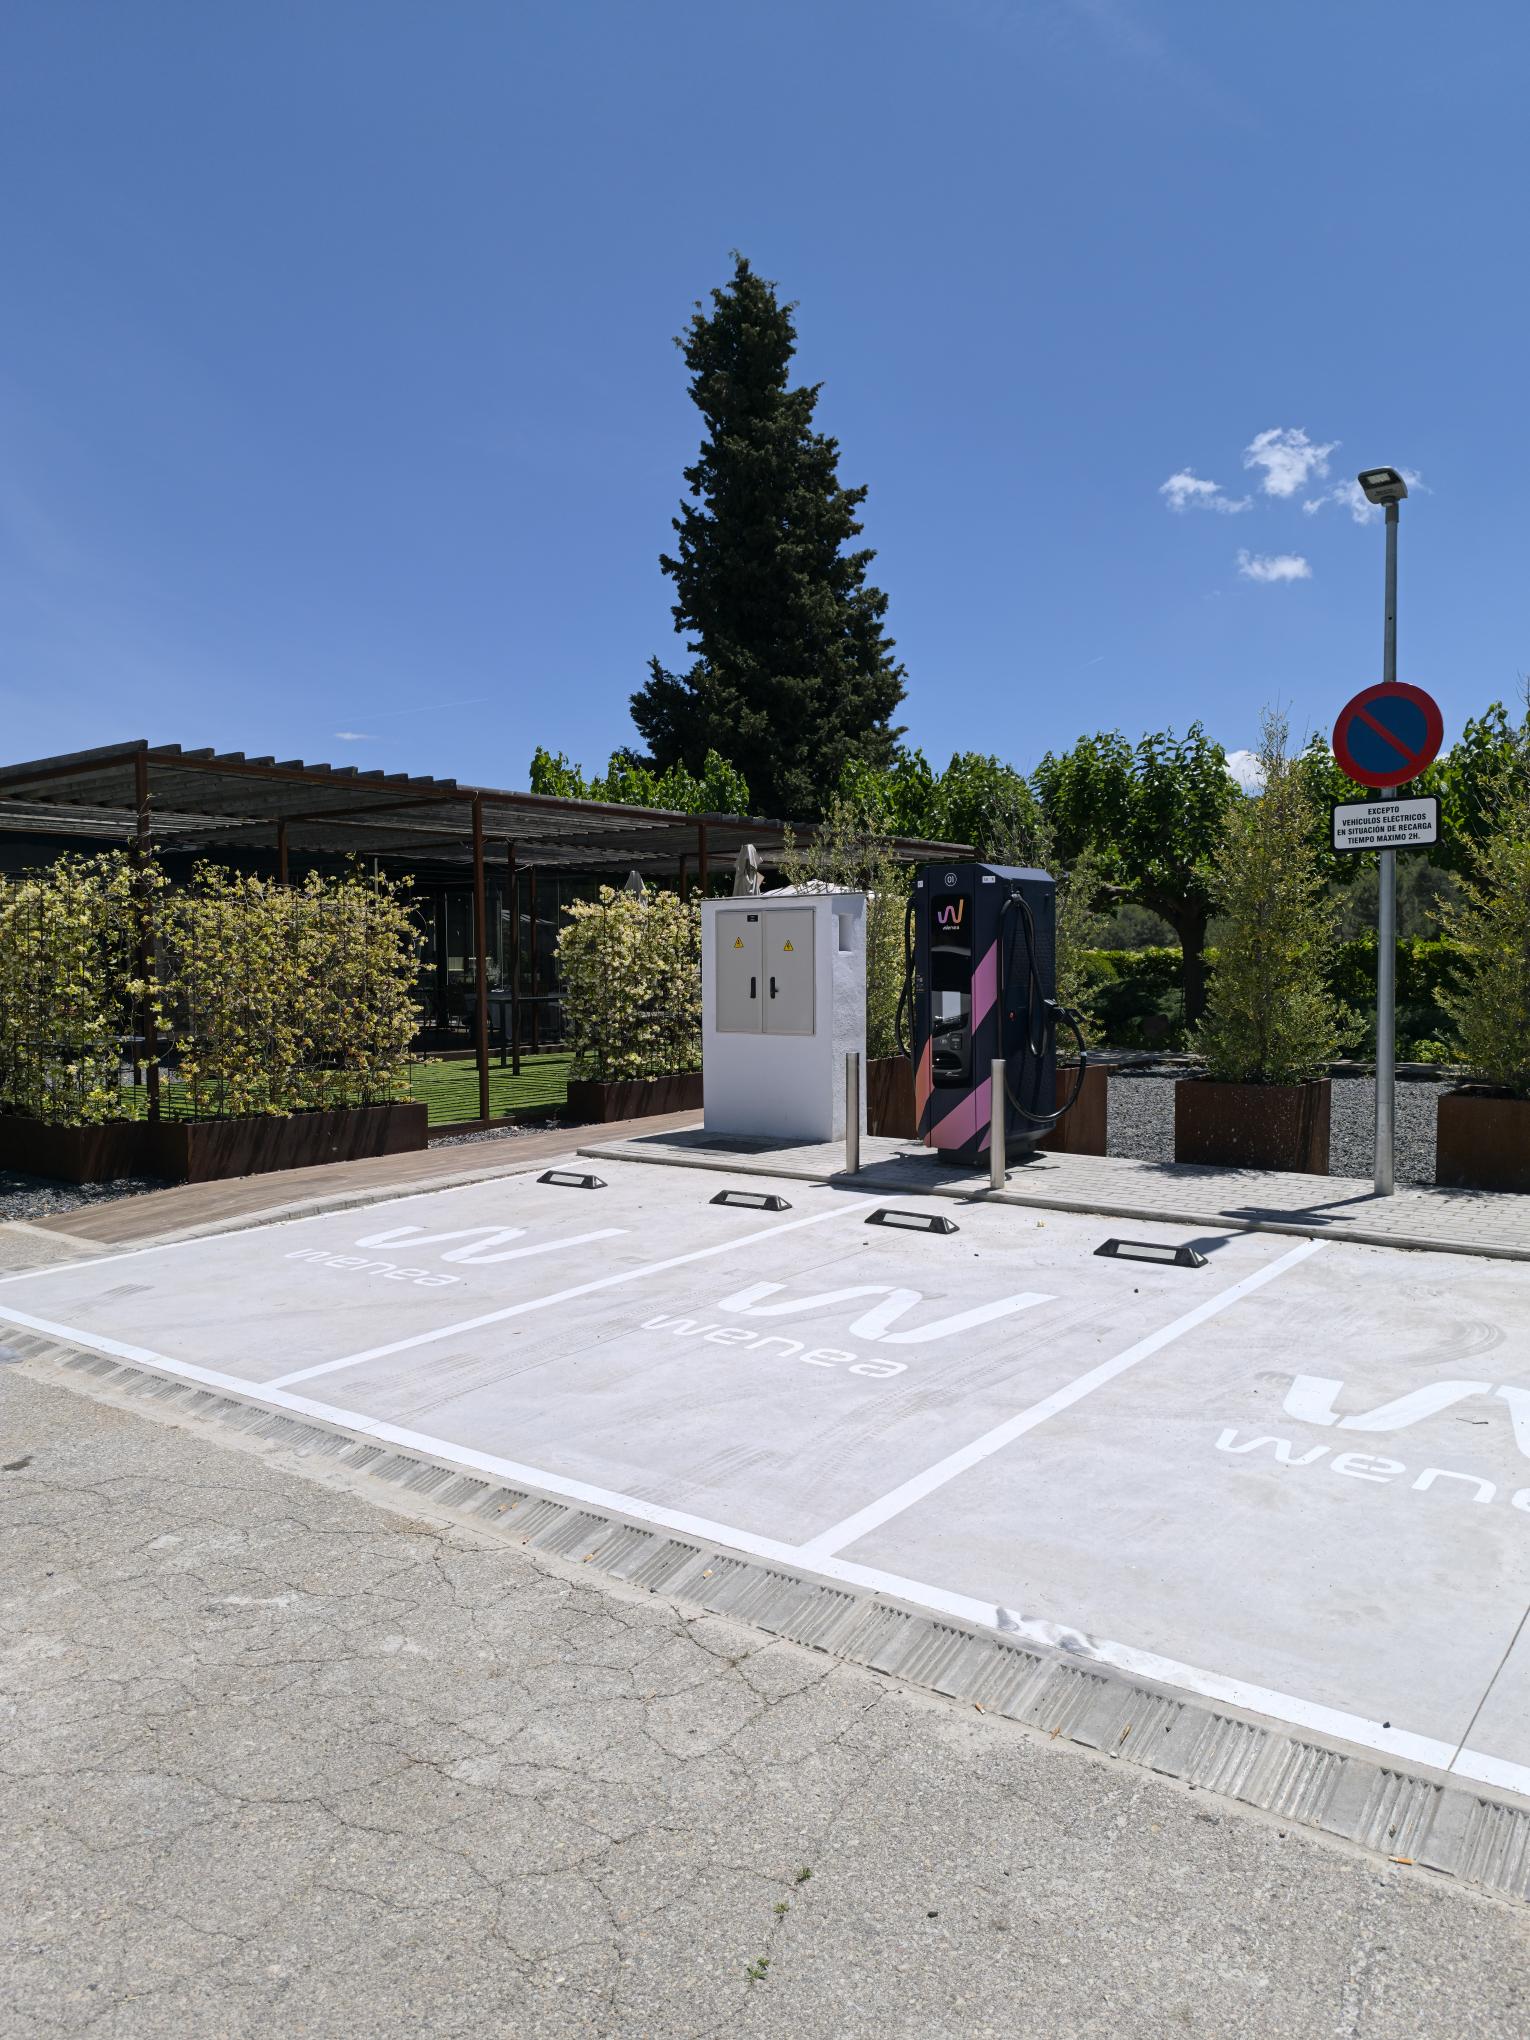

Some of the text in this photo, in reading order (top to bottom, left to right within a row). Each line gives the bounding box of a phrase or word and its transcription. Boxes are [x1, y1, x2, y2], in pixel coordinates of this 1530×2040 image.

[1367, 806, 1400, 815] EXCEPTO
[1337, 822, 1432, 836] EN SITUACIÓN DE RECARGA
[1348, 836, 1375, 844] TIEMPO
[284, 1248, 461, 1287] wenea
[640, 1314, 909, 1379] wenea
[1214, 1428, 1530, 1513] wen
